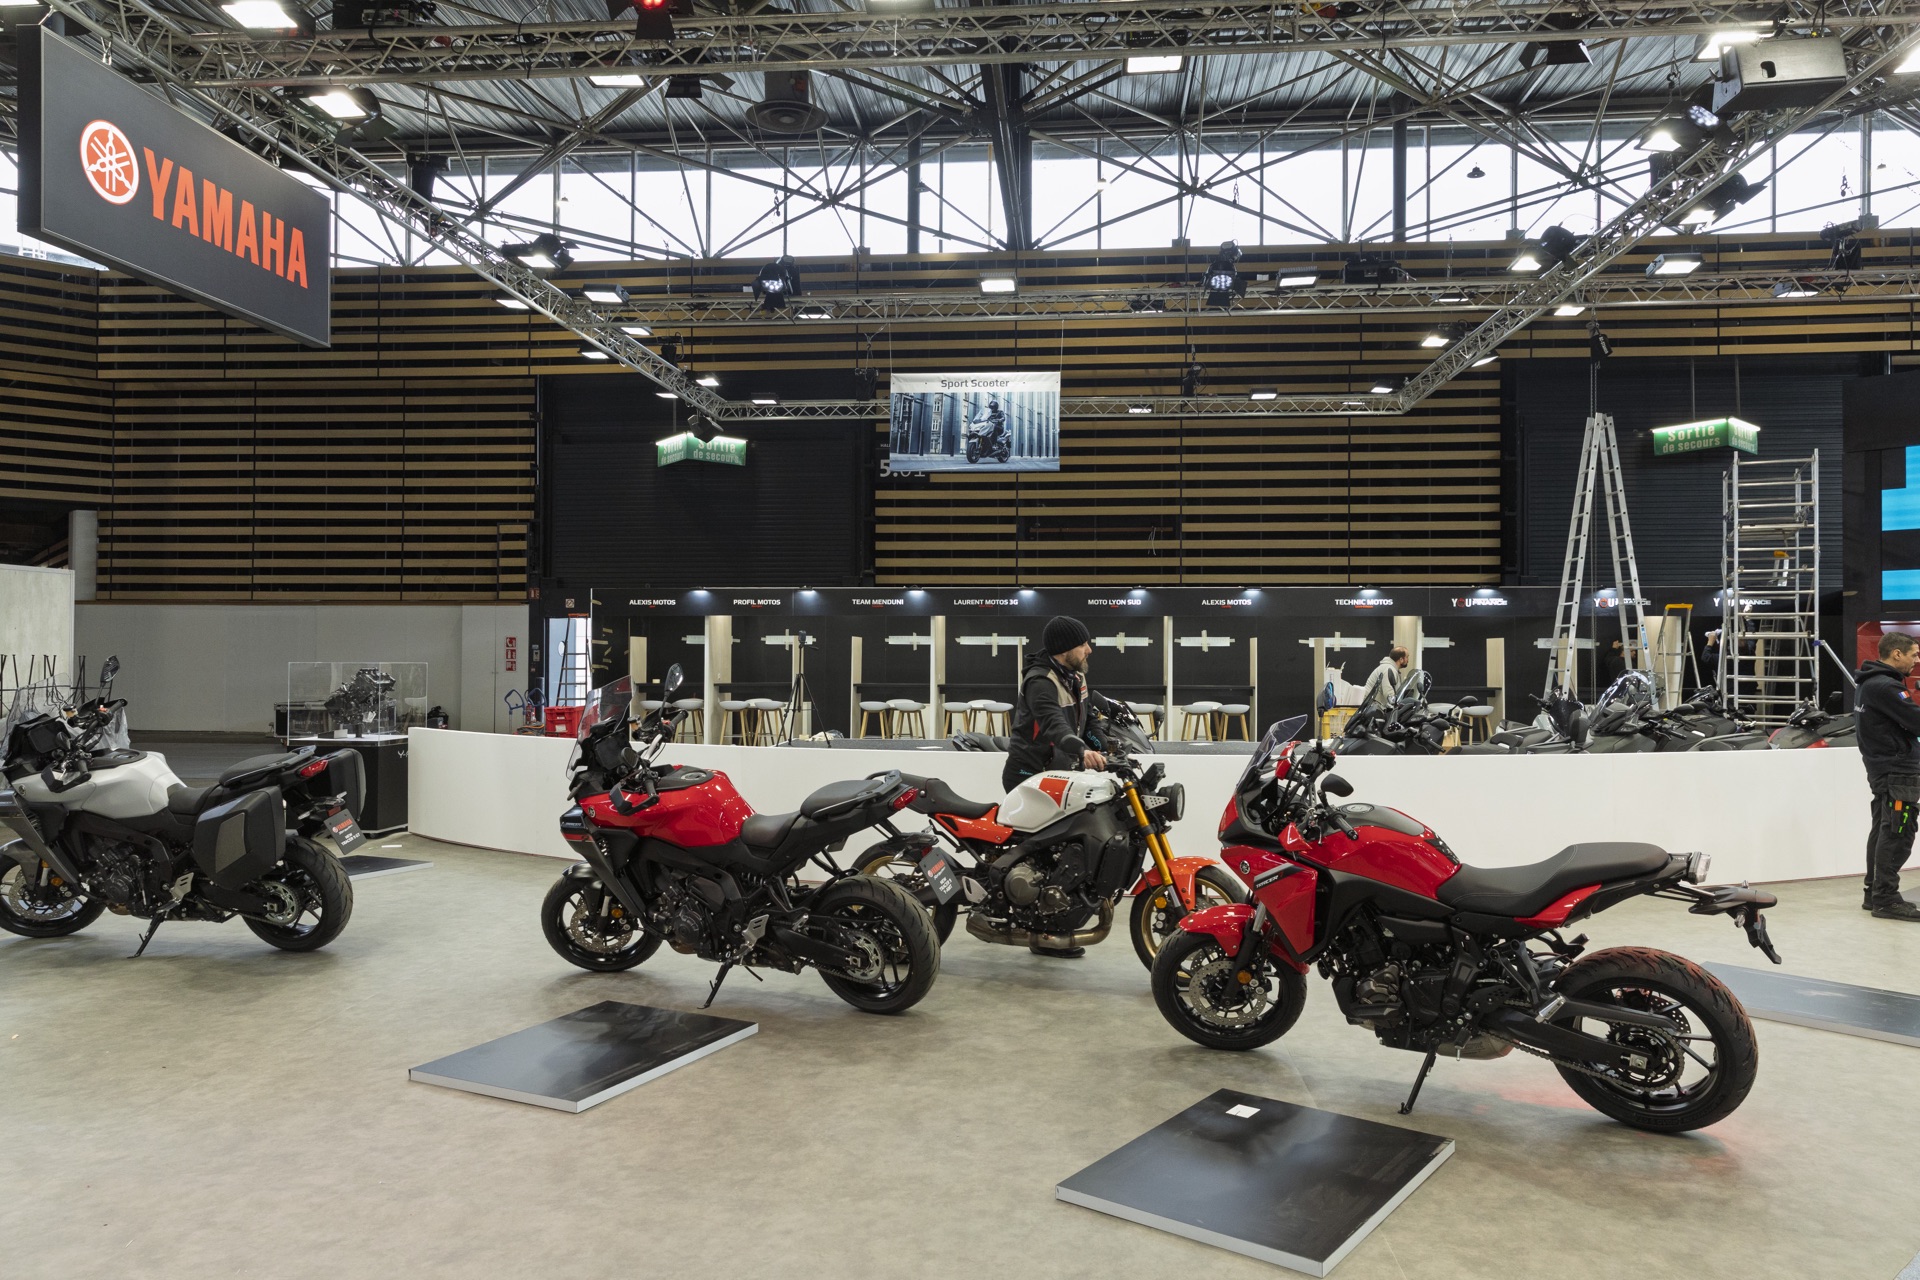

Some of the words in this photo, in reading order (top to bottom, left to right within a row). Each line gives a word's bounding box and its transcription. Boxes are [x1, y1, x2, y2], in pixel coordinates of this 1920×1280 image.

[143, 146, 308, 289] YAMAHA
[941, 379, 968, 389] Sport
[971, 379, 1010, 388] Scooter
[1668, 425, 1715, 442] Sortie
[1662, 443, 1675, 453] de
[1678, 437, 1720, 451] secours
[693, 449, 704, 459] de
[706, 452, 740, 464] secours
